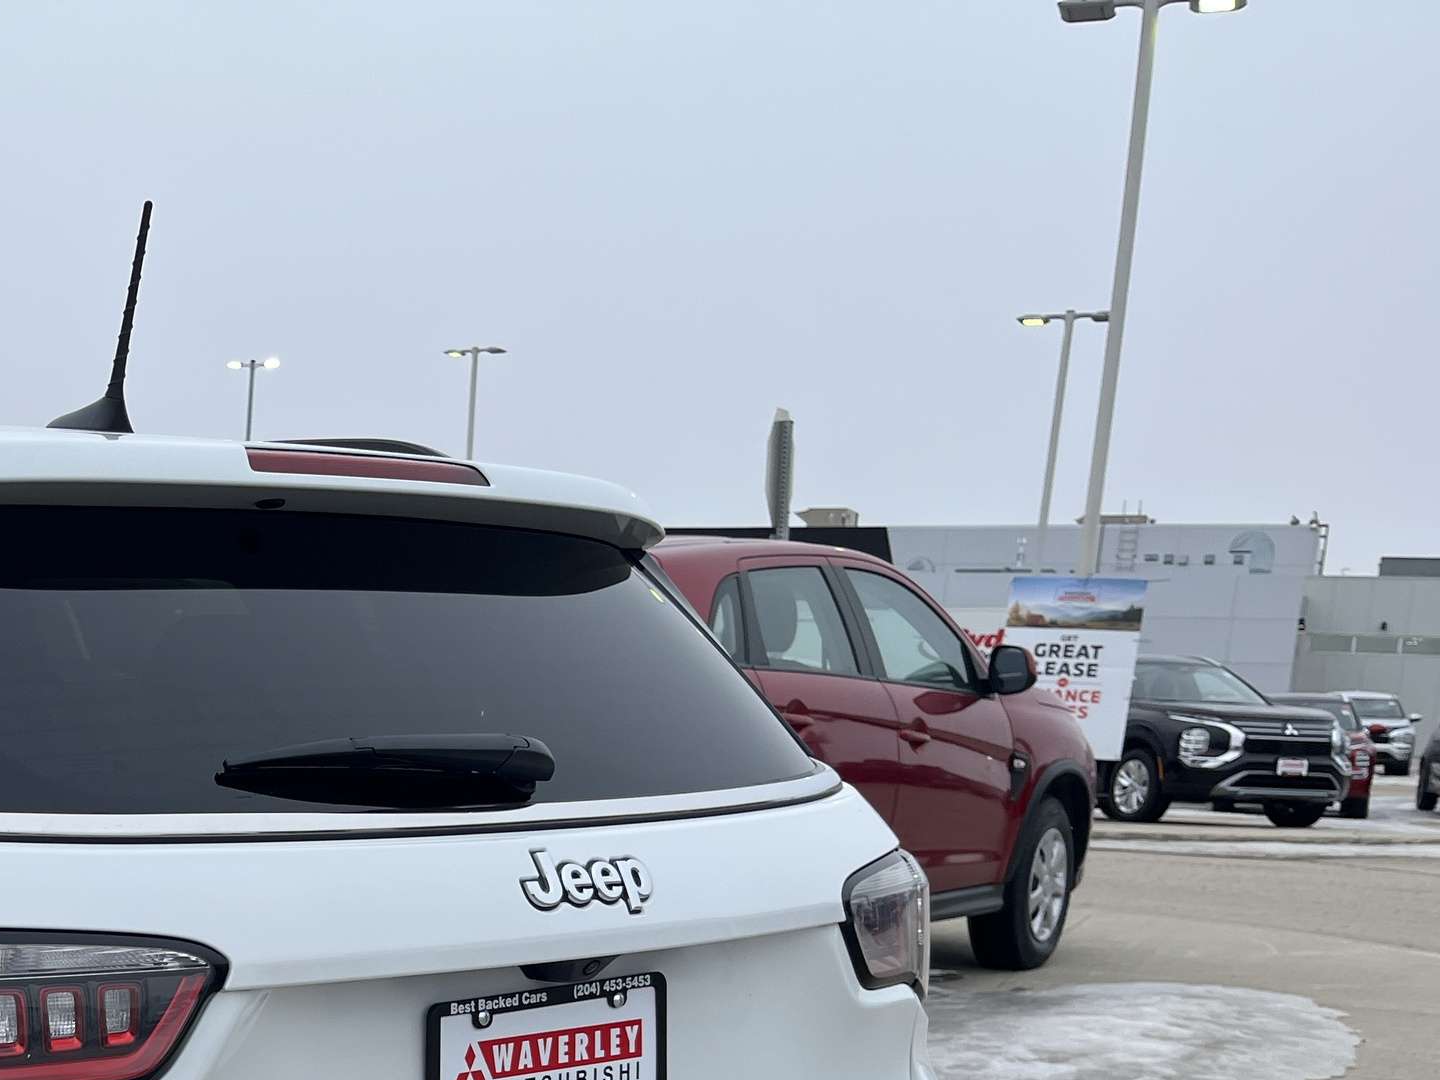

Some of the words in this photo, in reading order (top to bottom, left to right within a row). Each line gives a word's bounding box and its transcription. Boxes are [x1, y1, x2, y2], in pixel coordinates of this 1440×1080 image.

[1034, 643, 1104, 660] GREAT
[519, 848, 653, 915] Jeep
[450, 1002, 475, 1015] Best
[478, 995, 519, 1011] Backed
[522, 991, 547, 1004] Cars
[573, 981, 600, 999] (204)
[603, 974, 651, 992] 453-5453
[492, 1025, 639, 1074] WAVERLEY
